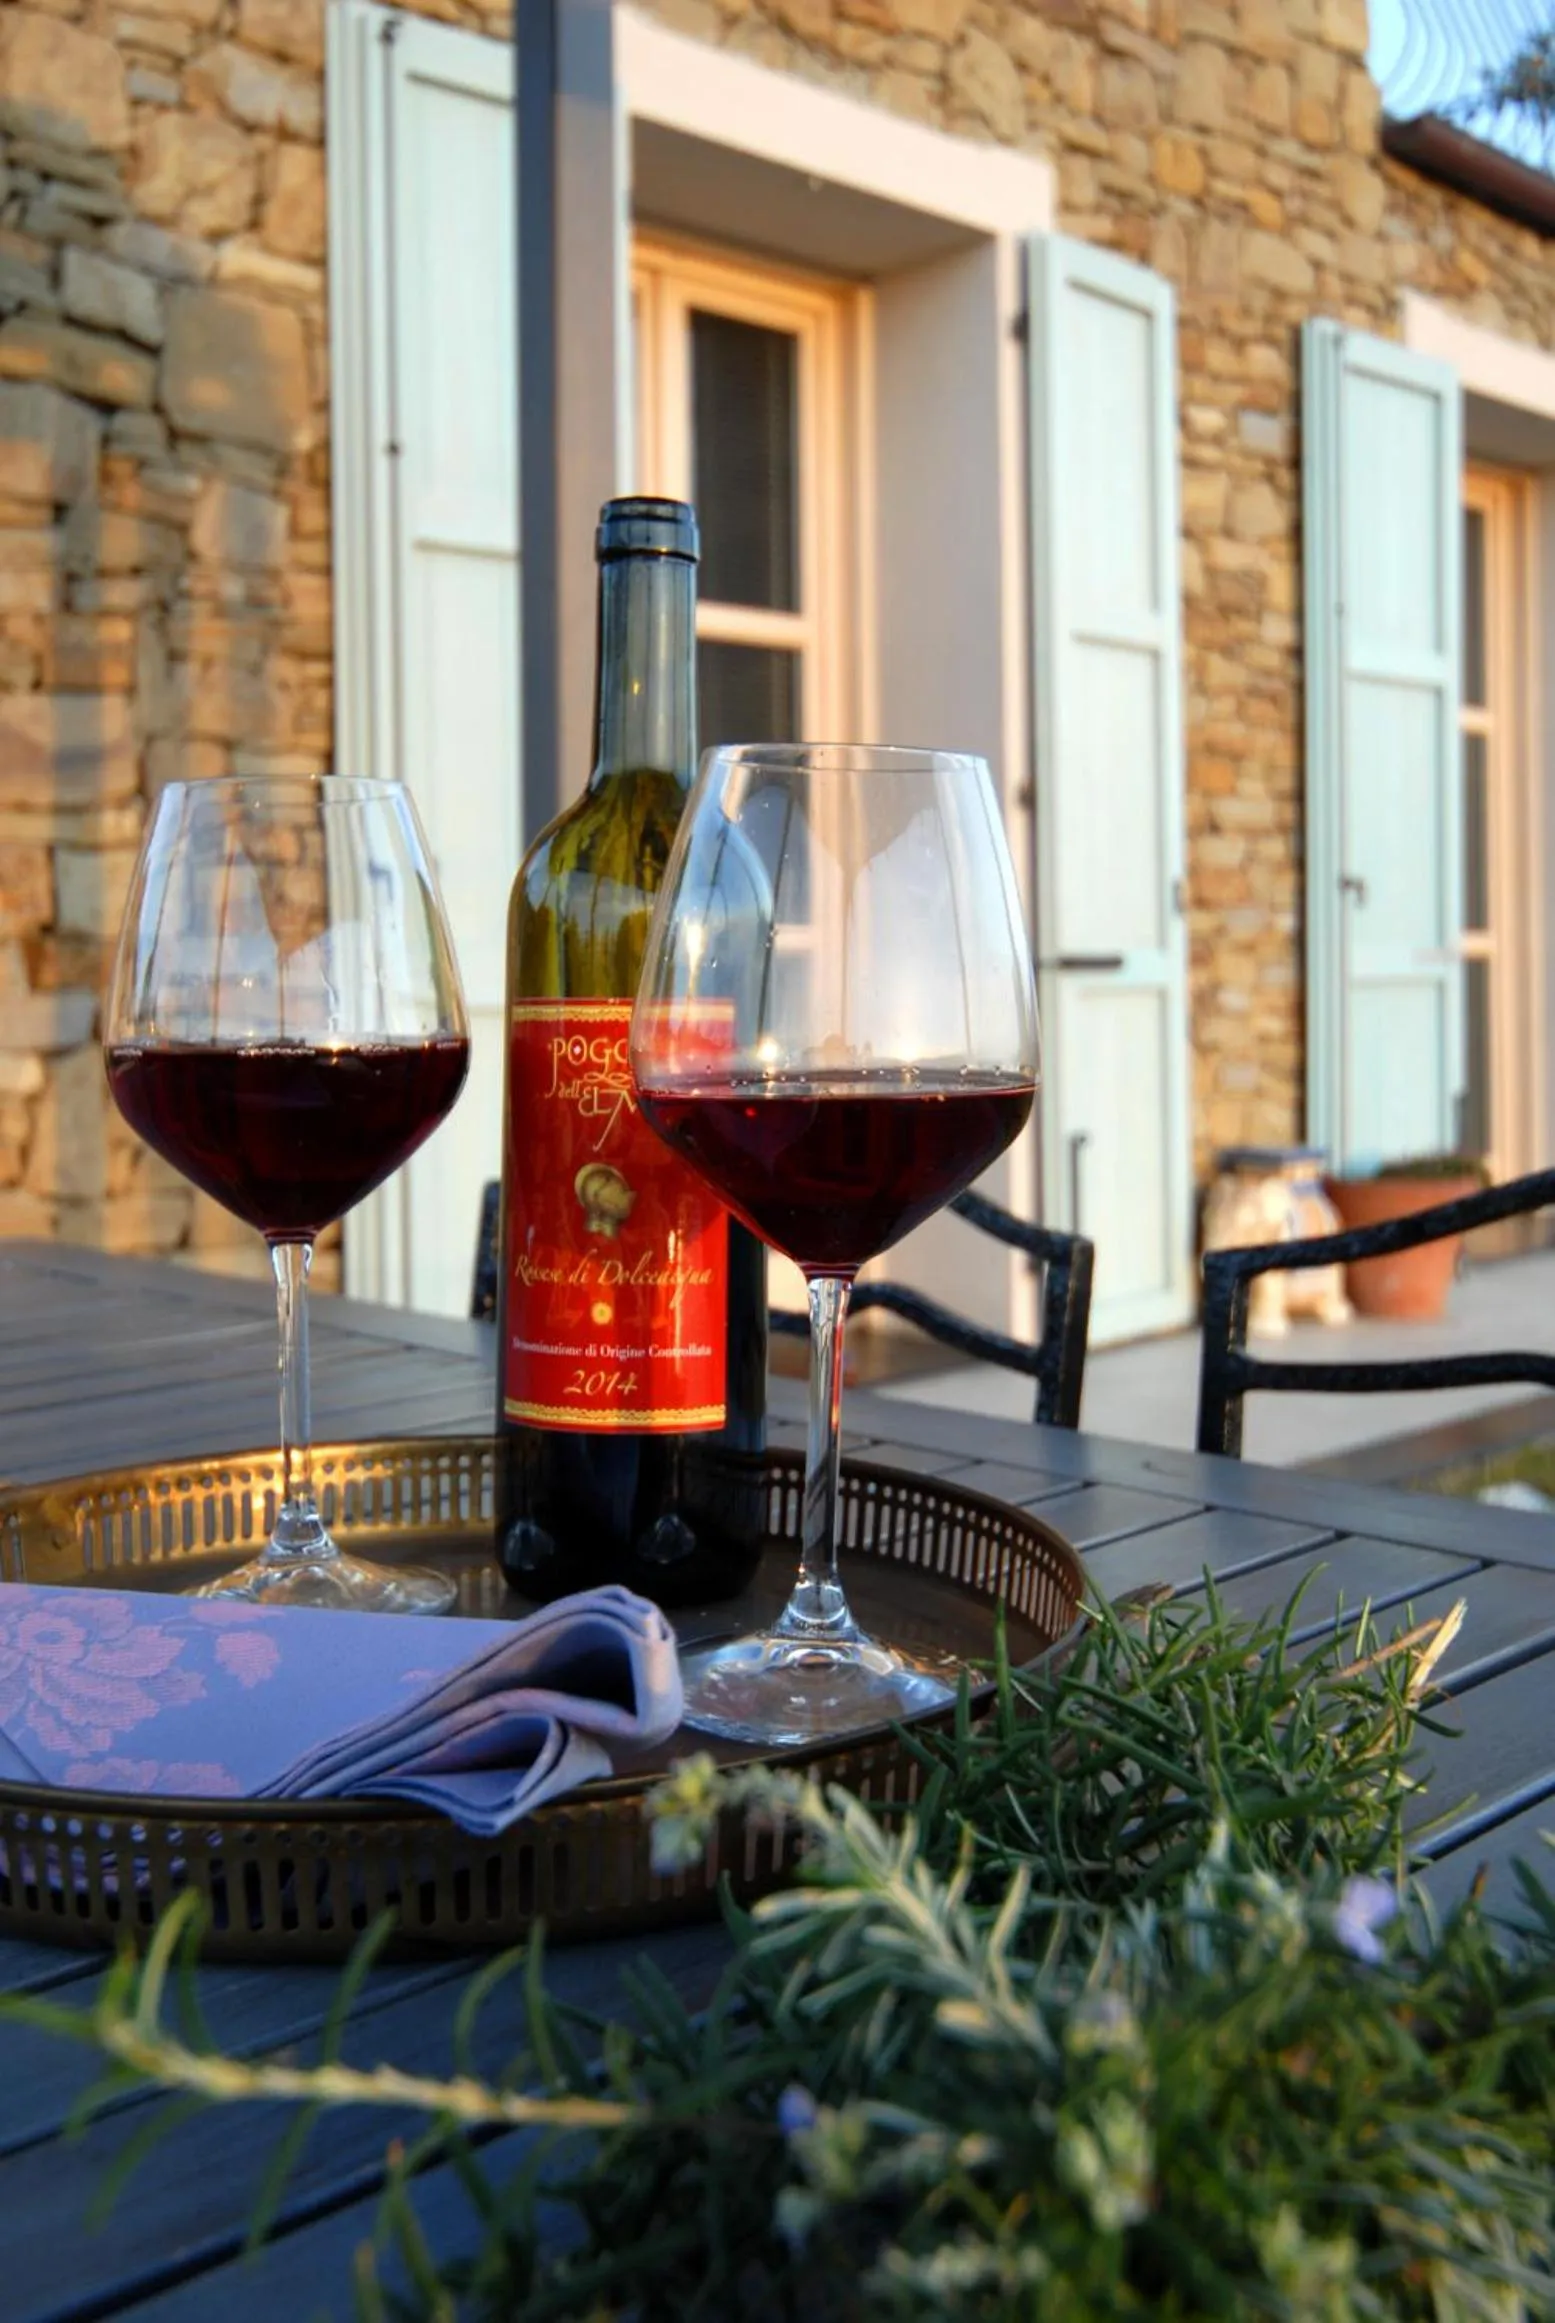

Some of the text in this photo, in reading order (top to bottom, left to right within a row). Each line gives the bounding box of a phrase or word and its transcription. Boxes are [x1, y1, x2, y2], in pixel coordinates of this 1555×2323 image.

[569, 1248, 598, 1285] di
[585, 1343, 597, 1357] di
[600, 1343, 646, 1361] Origine
[648, 1342, 713, 1358] Controllata
[563, 1369, 638, 1396] 2014
